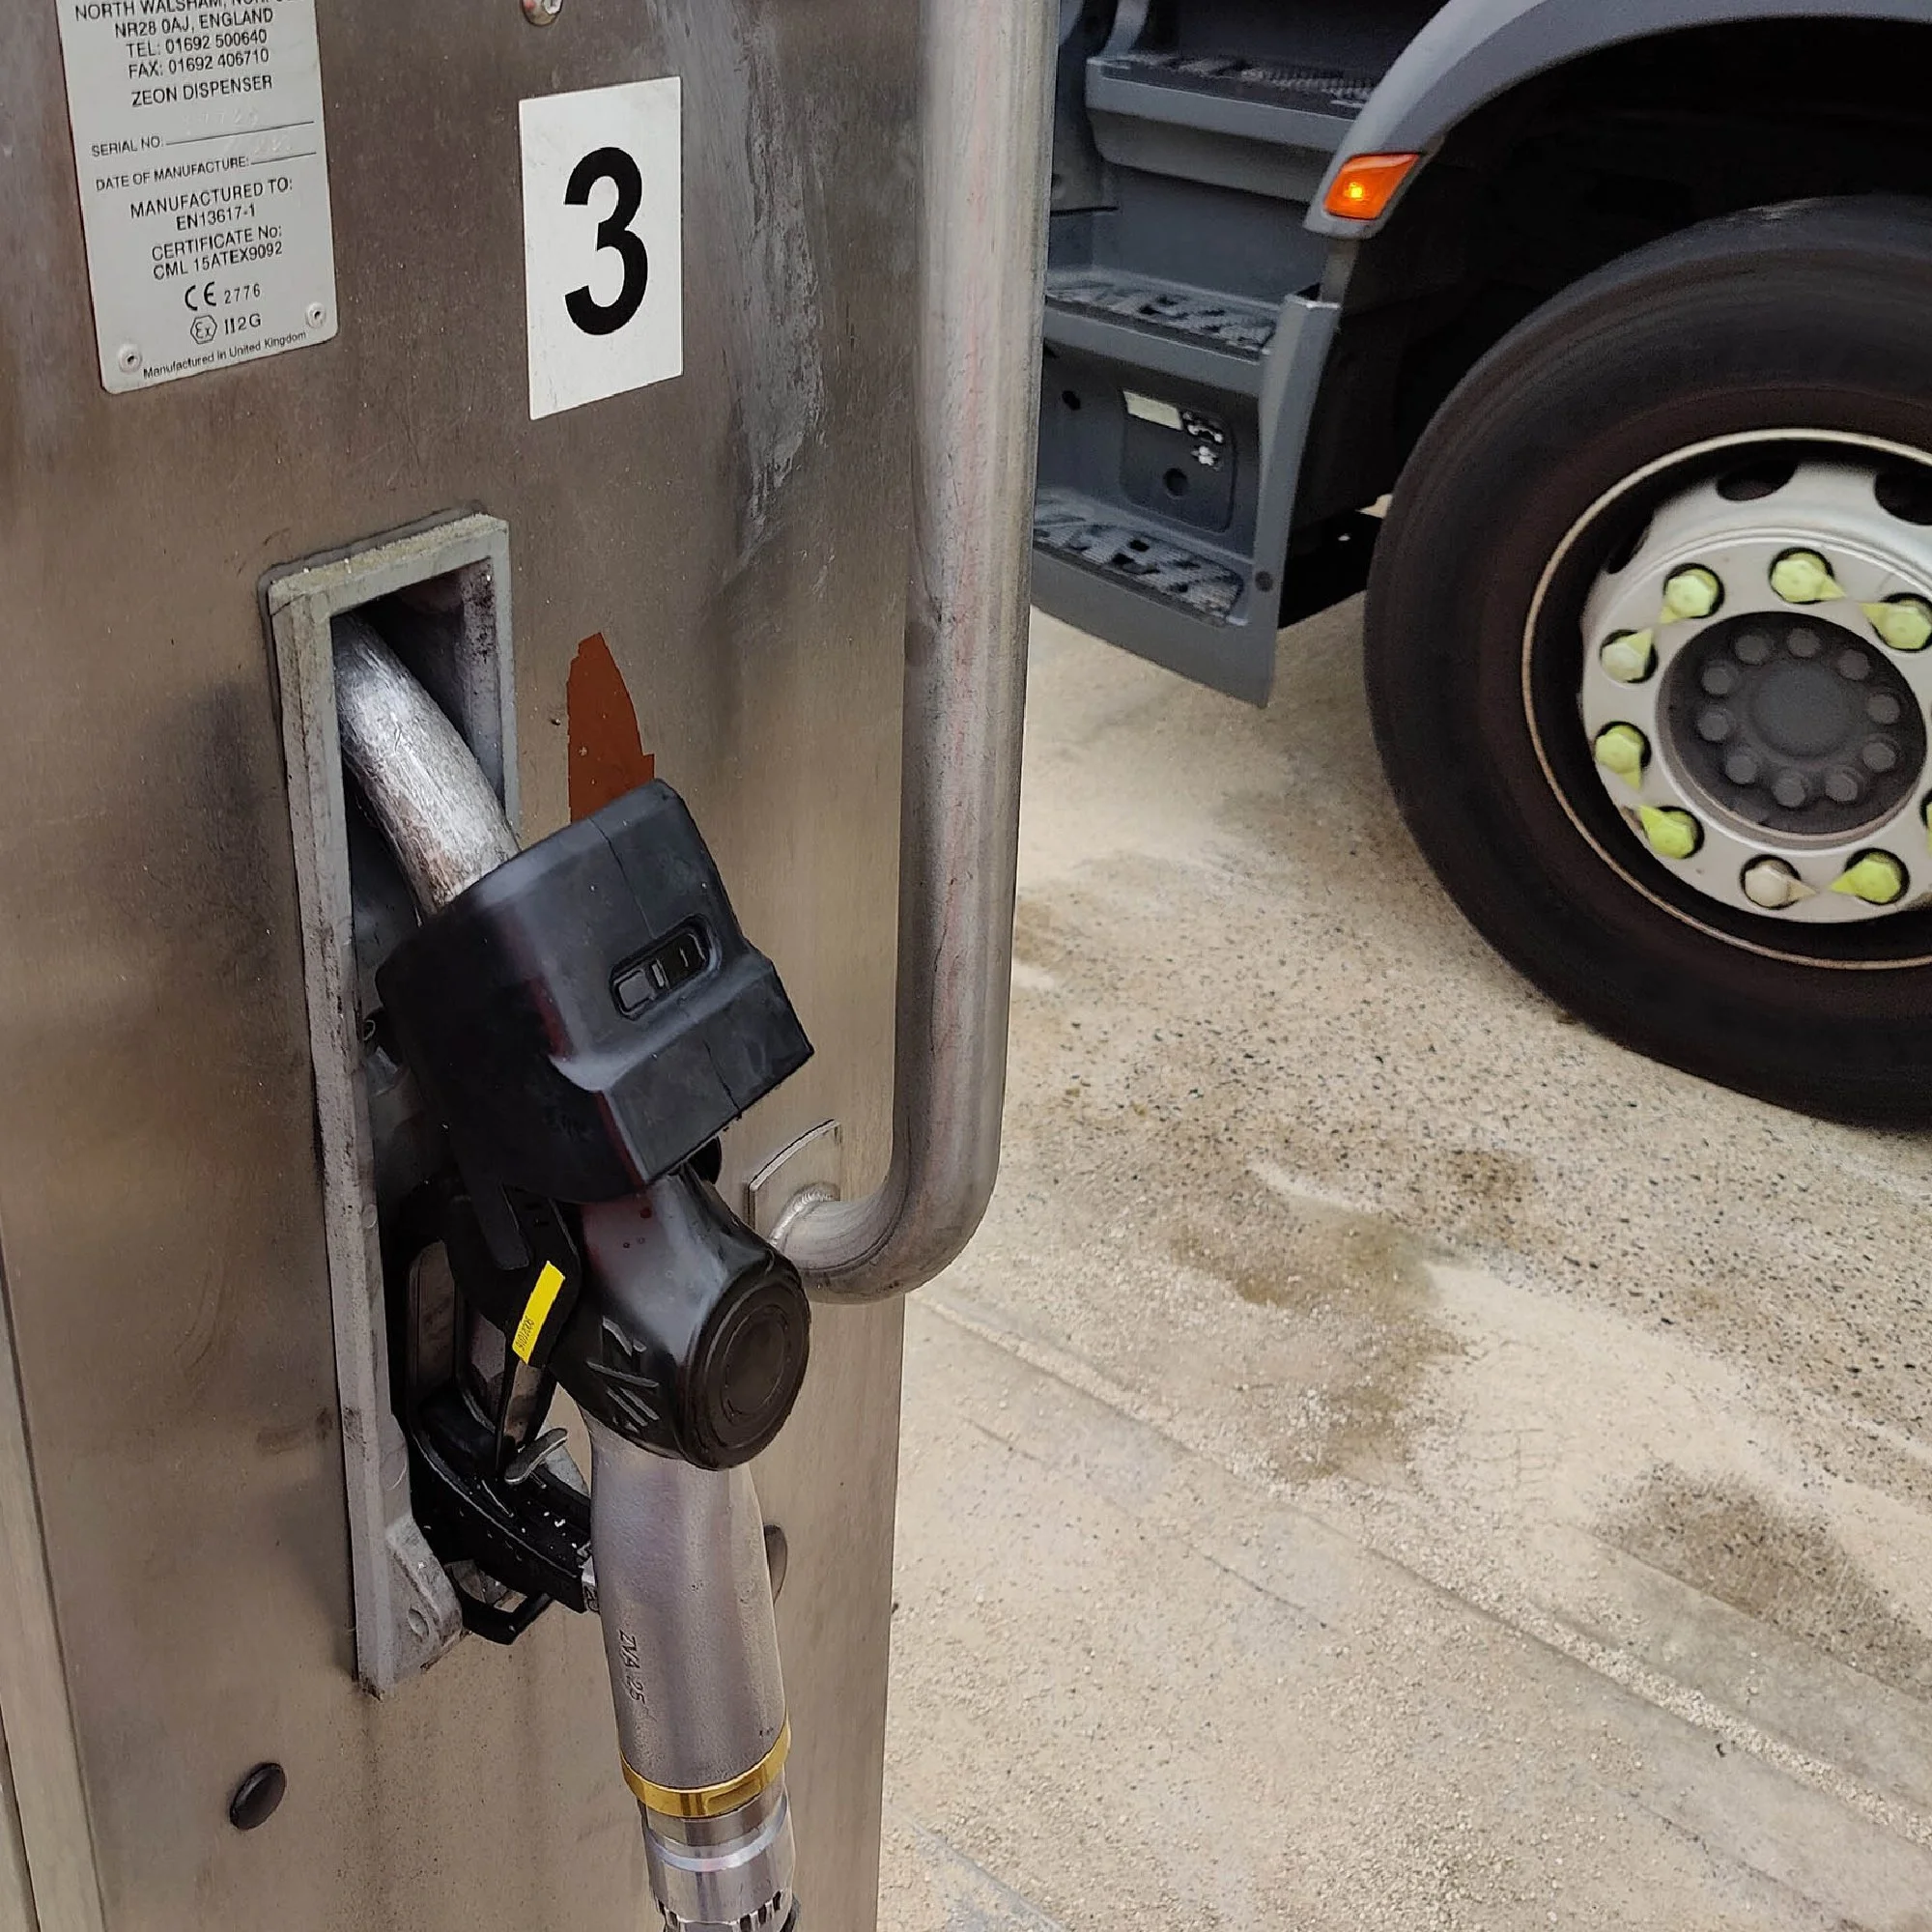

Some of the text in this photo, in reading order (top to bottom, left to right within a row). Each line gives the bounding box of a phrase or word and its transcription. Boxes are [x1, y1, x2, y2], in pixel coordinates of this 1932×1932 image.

[75, 1, 134, 21] NORTH
[115, 21, 156, 38] NR28
[200, 8, 273, 29] ENGLAND
[127, 29, 267, 58] TEL: 01692 500640
[129, 48, 269, 79] FAX: 01692 406710
[131, 74, 272, 107] ZEON DISPENSER
[91, 136, 163, 156] SERIAL NO:
[96, 156, 249, 191] DATE OF MANUFACTURE:
[130, 177, 293, 219] MANUFACTURED TO:
[176, 203, 256, 231] EN13617-1
[152, 225, 282, 262] CERTIFICATE No:
[564, 147, 648, 335] 3
[154, 242, 283, 280] CML 15ATEX9092
[224, 284, 261, 304] 2776
[143, 353, 214, 380] Manufactured
[229, 342, 261, 357] United
[264, 330, 307, 352] Kingdom
[618, 1629, 640, 1669] ZVA
